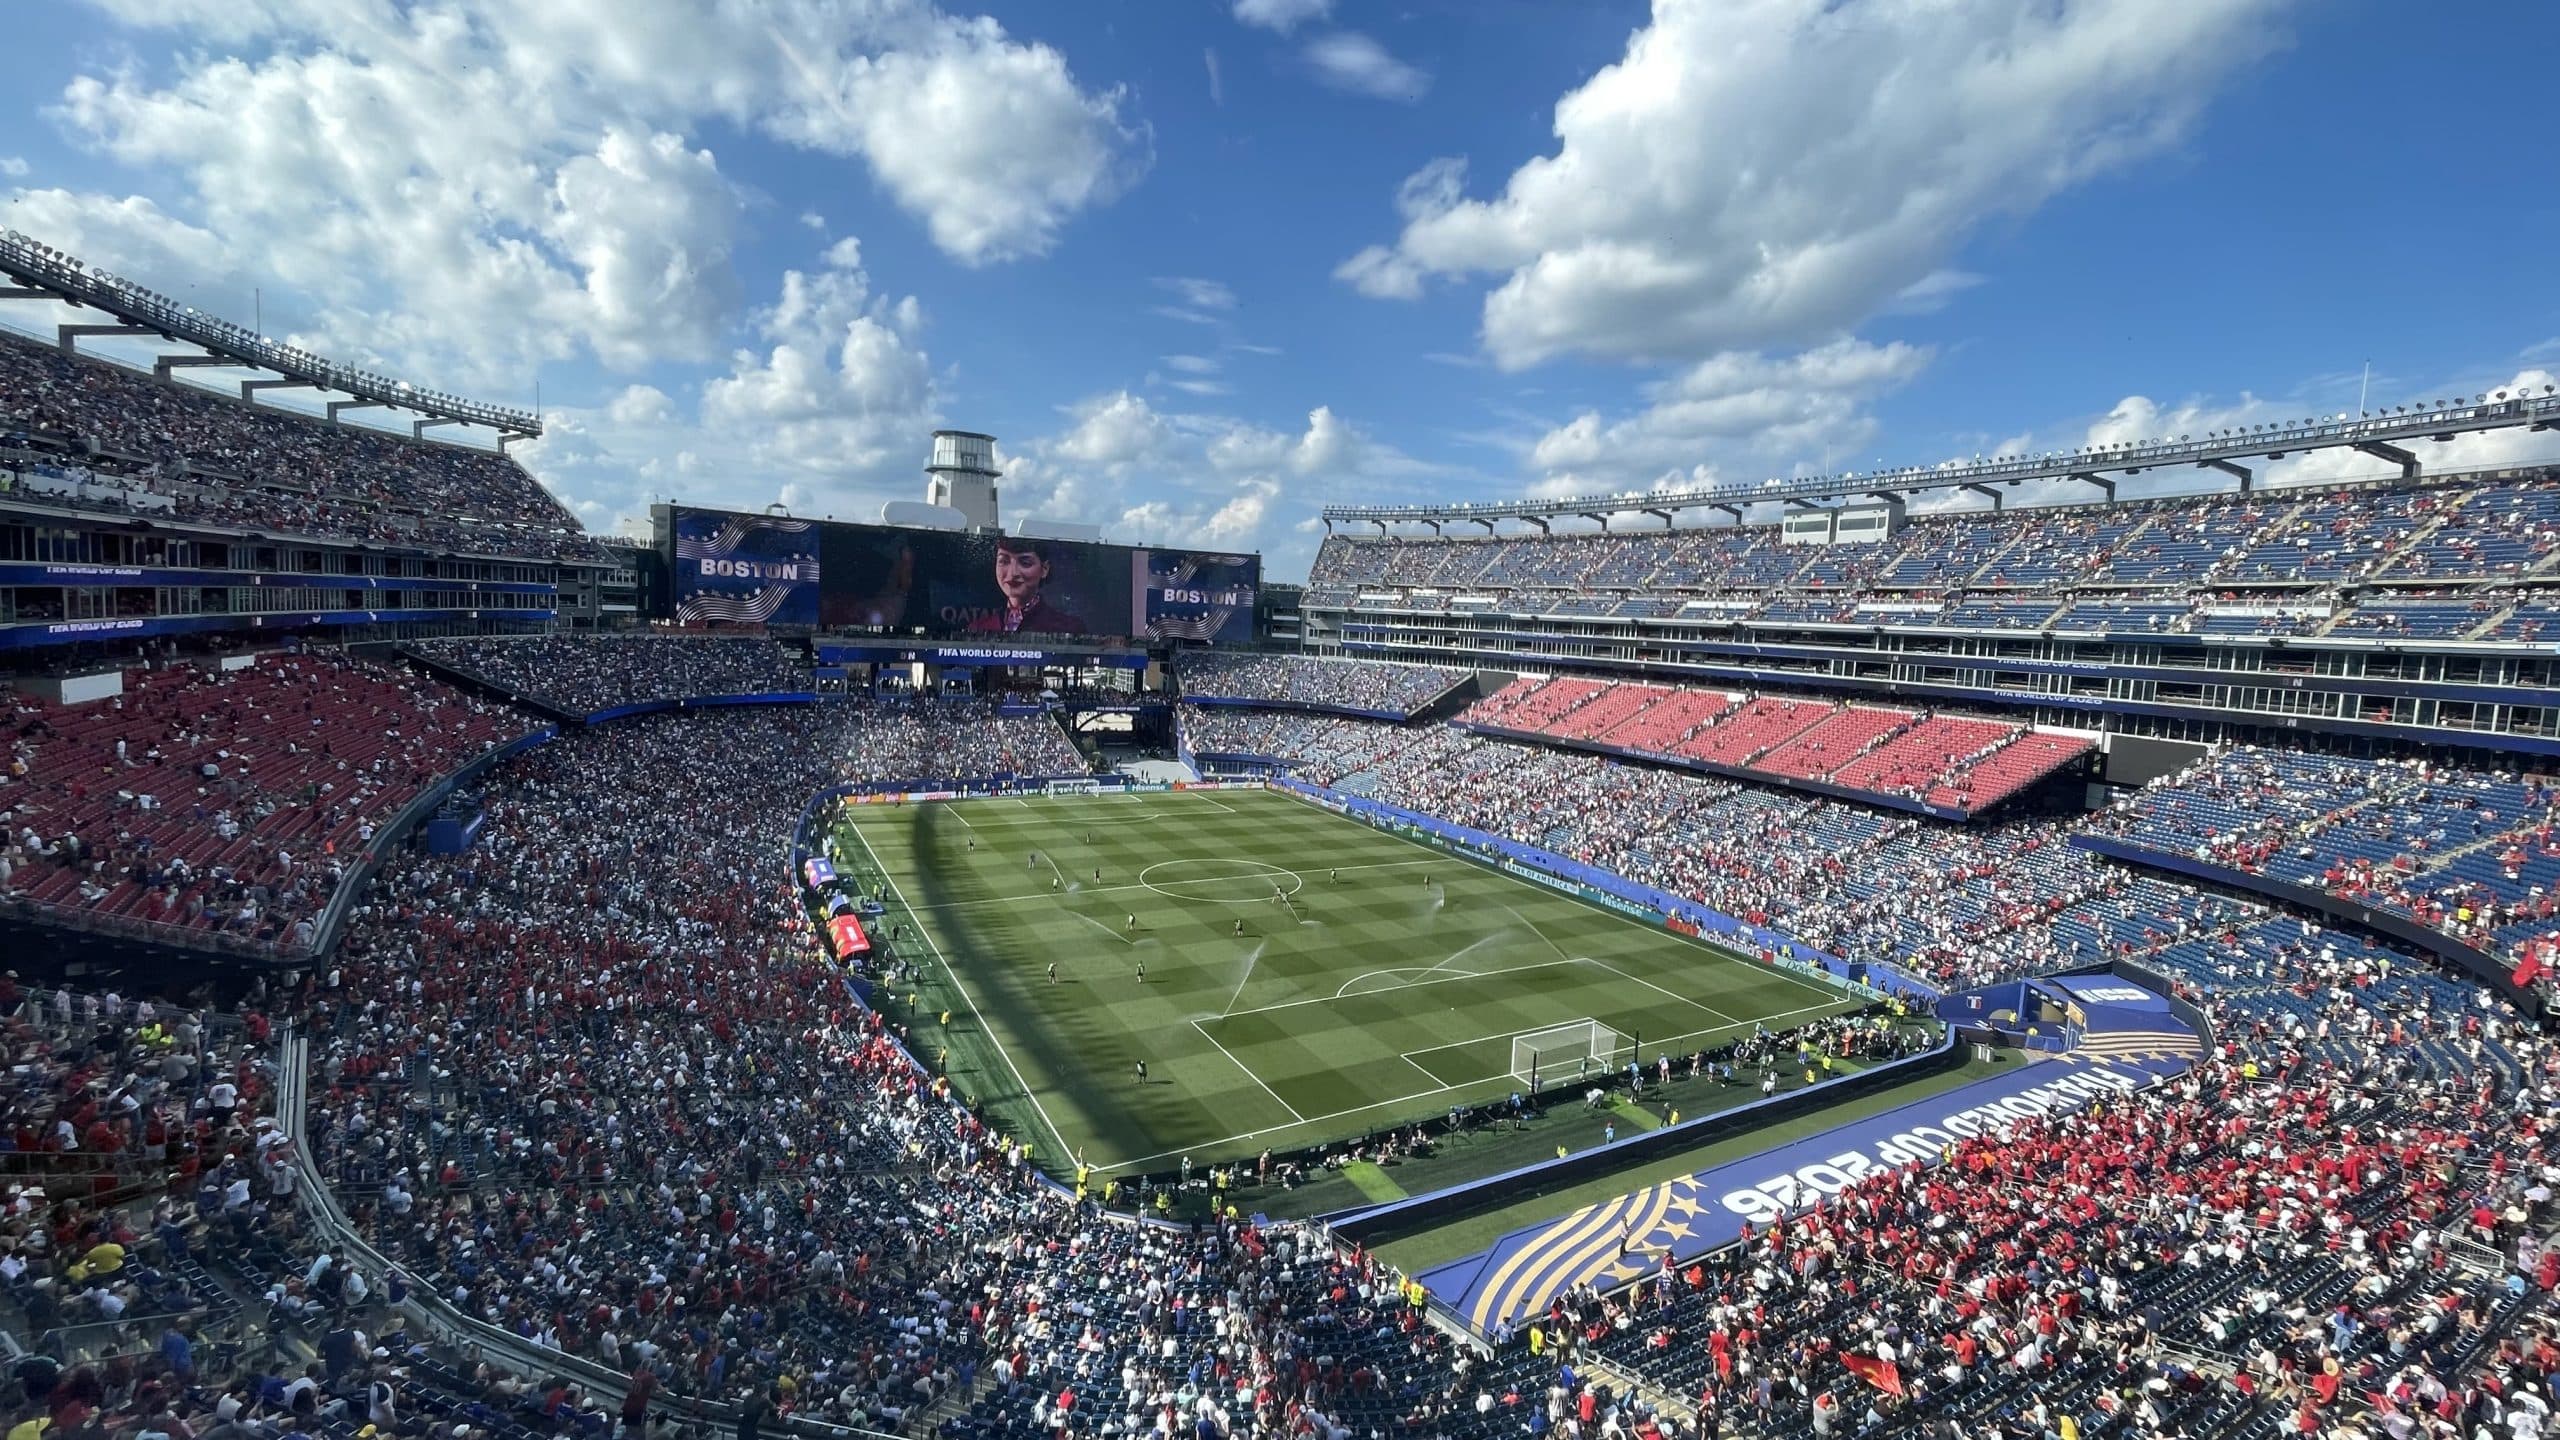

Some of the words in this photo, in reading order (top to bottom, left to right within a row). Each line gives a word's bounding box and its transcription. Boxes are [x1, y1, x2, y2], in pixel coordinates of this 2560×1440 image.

[701, 559, 798, 580] BOSTON
[1164, 588, 1237, 606] BOSTON
[938, 647, 959, 657] FIFA
[959, 648, 992, 658] WORLD
[993, 649, 1011, 658] CUP
[1011, 650, 1042, 659] 2026
[2015, 692, 2047, 700] WORLD
[2048, 694, 2067, 702] CUP
[2068, 696, 2103, 705] 2026
[1132, 784, 1166, 792] Hisense
[1506, 862, 1526, 873] BANK
[1536, 874, 1569, 890] AMERICA
[1600, 894, 1643, 917] Hisense
[1697, 929, 1763, 960] McDonald's
[1786, 960, 1813, 975] Dove
[1844, 981, 1873, 997] Dove
[2043, 1067, 2136, 1102] FIFA
[1942, 1088, 2079, 1138] WORLD
[1875, 1126, 1955, 1168] CUP
[1722, 1150, 1889, 1223] 2026
